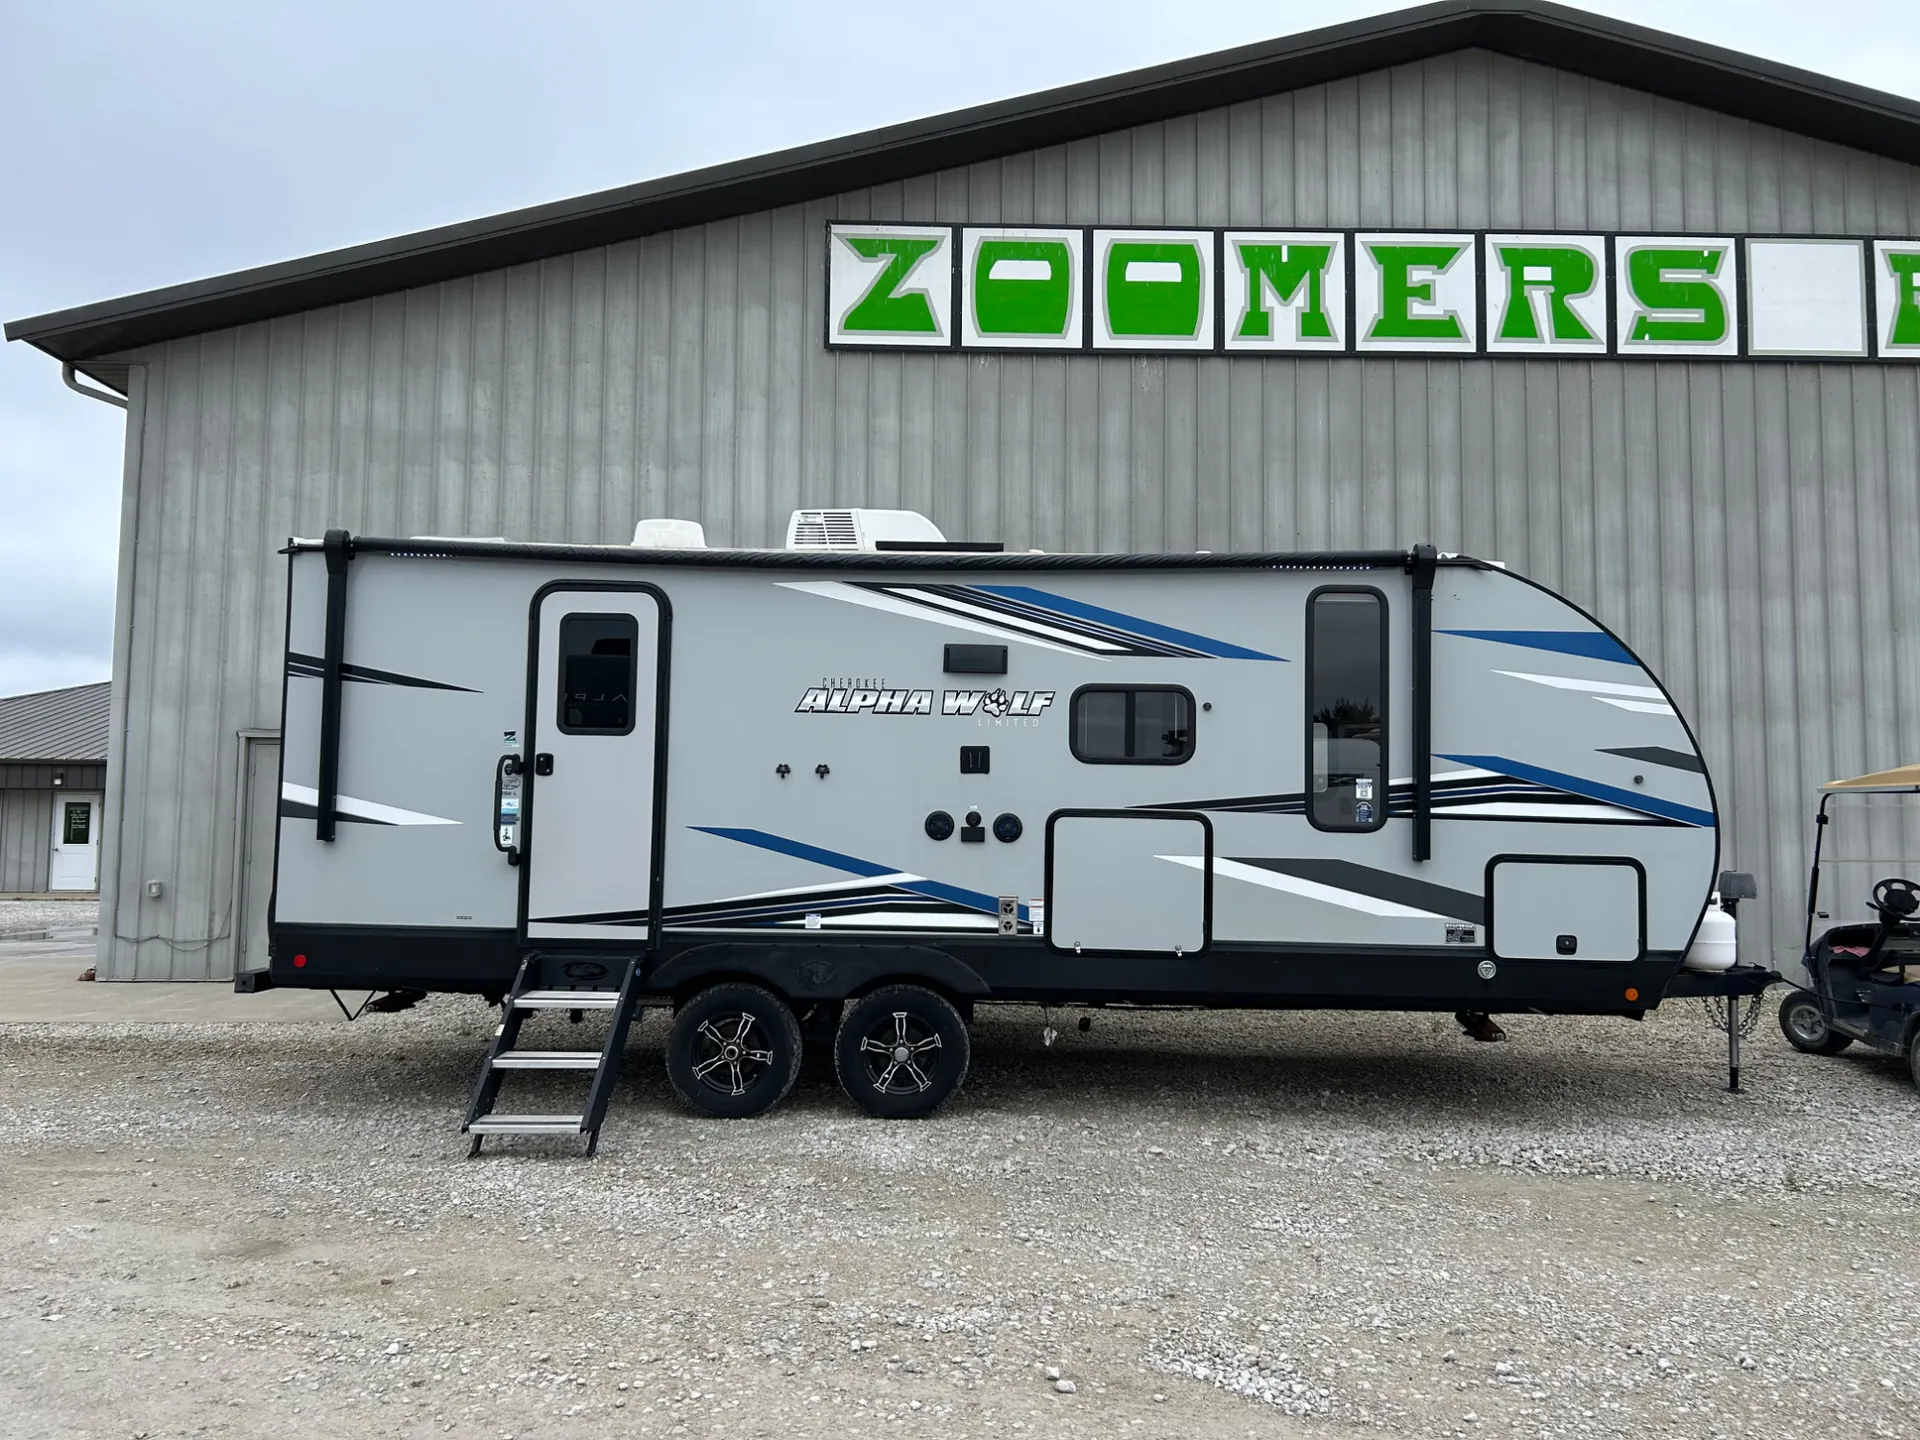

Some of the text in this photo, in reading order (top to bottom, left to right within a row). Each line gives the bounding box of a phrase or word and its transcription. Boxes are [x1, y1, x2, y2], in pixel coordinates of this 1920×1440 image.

[832, 233, 1731, 345] ZOOMERS
[822, 677, 886, 689] CHEROKEE
[794, 687, 934, 715] ALPHA
[978, 718, 1039, 727] LIMITED
